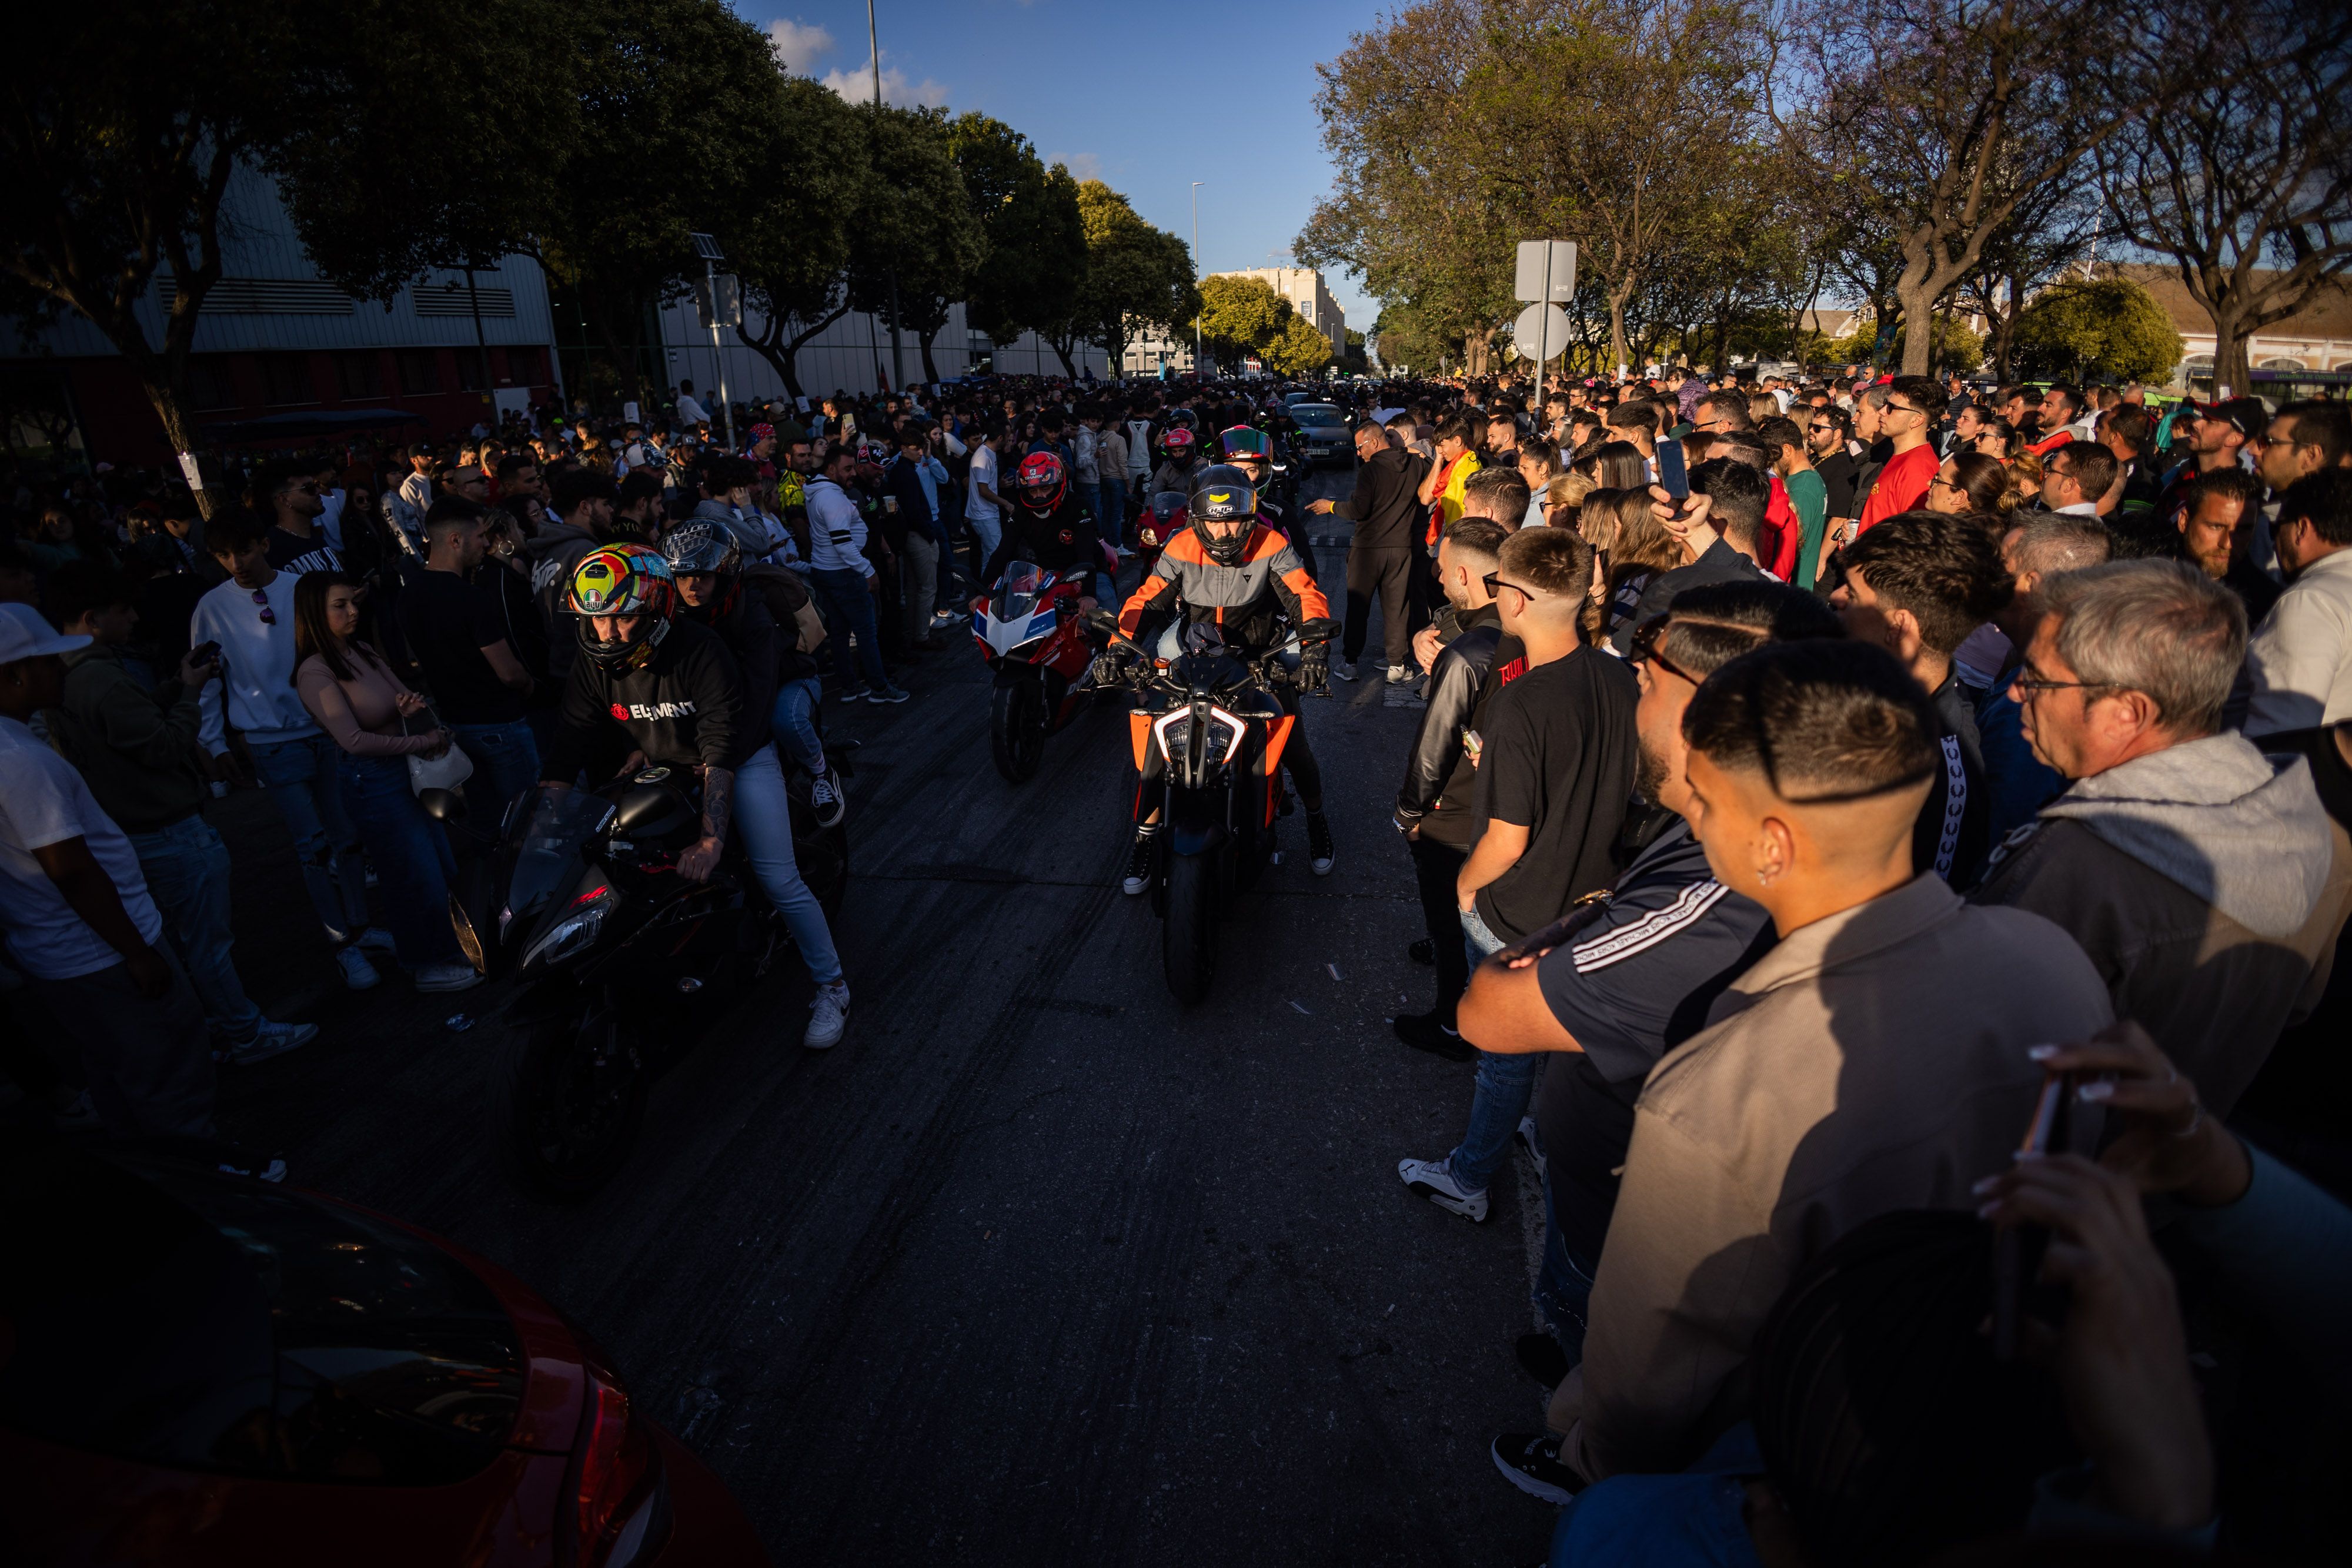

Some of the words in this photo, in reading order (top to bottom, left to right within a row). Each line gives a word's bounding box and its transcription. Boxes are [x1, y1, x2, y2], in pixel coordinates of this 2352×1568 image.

[629, 700, 697, 721] ELEMENT
[1651, 917, 1672, 931] KORS
[1616, 928, 1650, 947] MICHAEL
[1597, 943, 1616, 956] KORS
